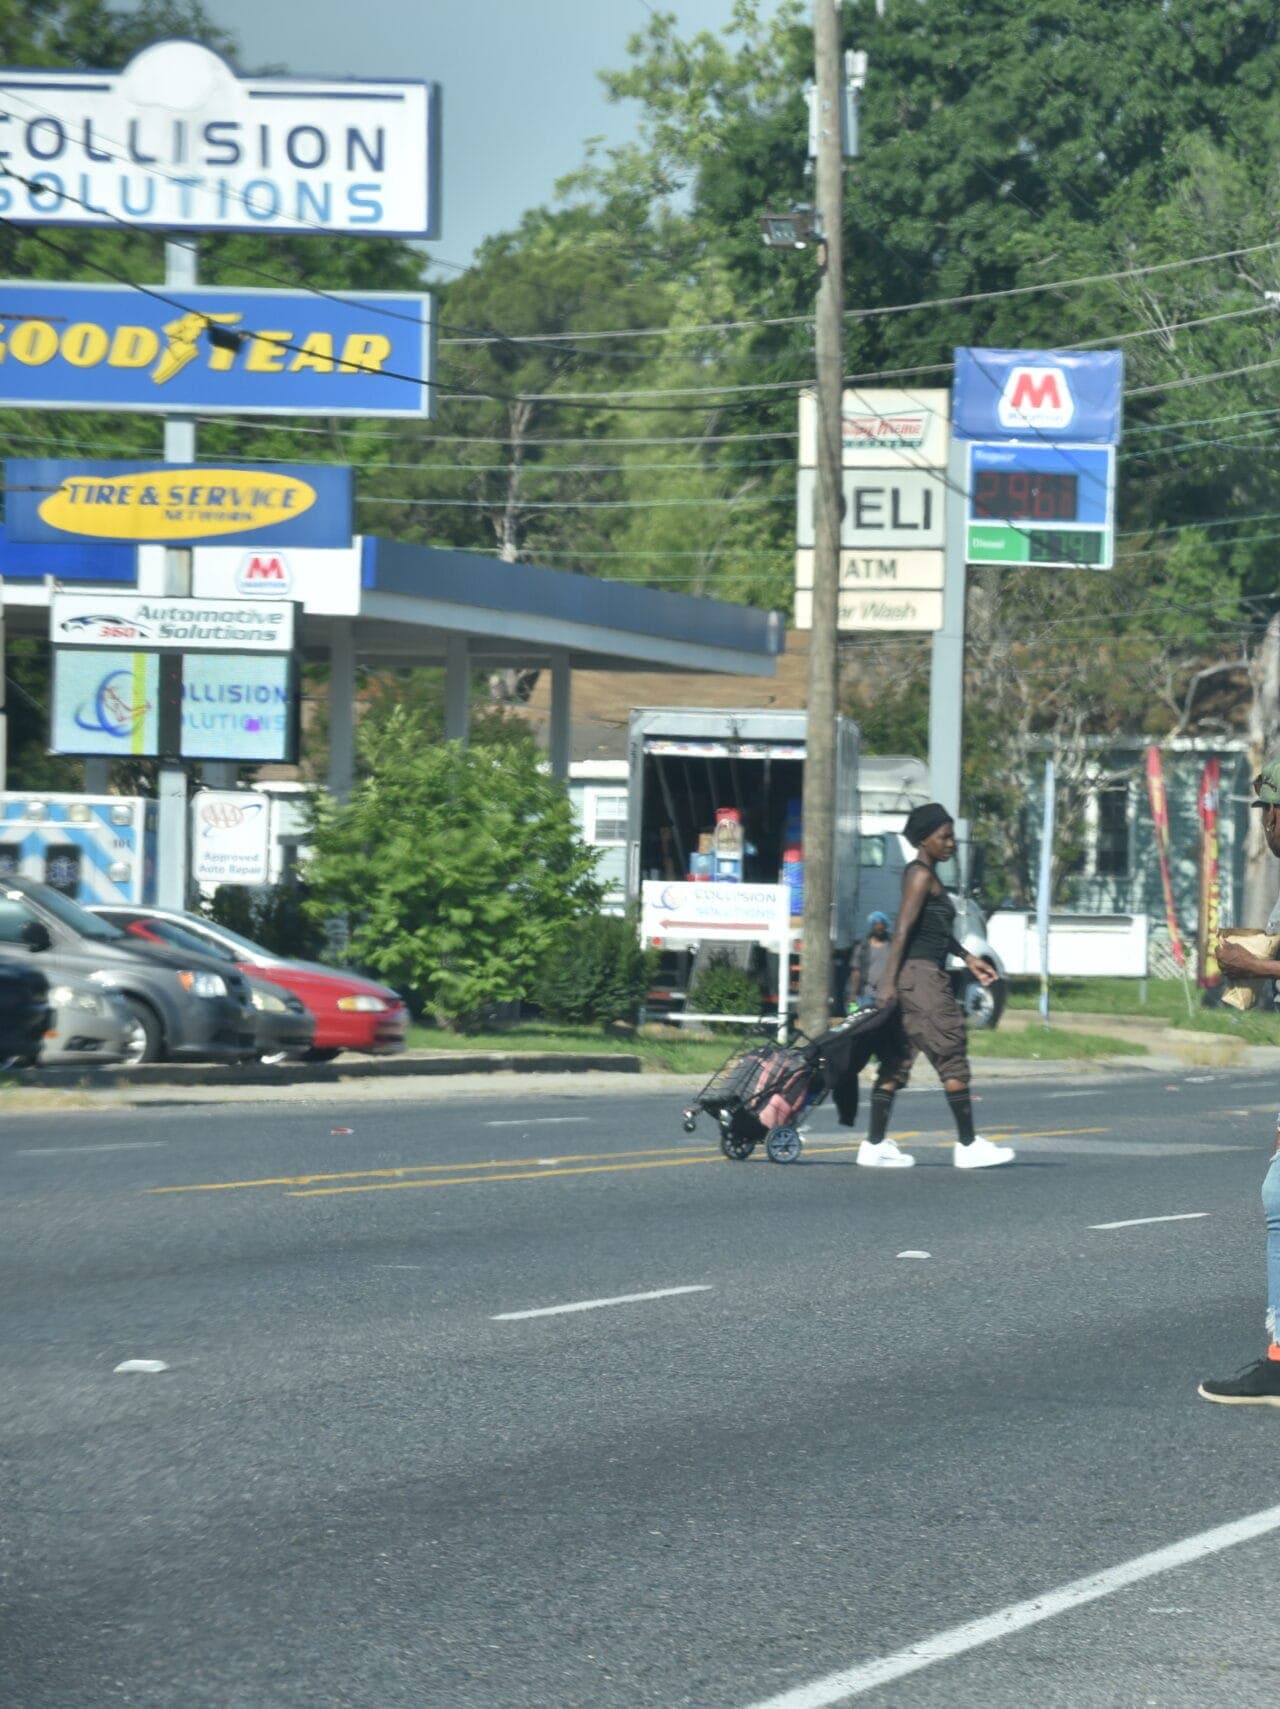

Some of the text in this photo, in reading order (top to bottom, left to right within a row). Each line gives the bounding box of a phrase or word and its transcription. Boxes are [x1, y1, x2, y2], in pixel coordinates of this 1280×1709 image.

[0, 319, 391, 374] OODEAR
[1010, 372, 1062, 409] M
[68, 483, 298, 509] TIRE & SERVICE
[812, 485, 933, 531] ELI
[244, 556, 286, 580] M
[844, 558, 897, 579] ATM
[136, 604, 285, 625] Automotive
[838, 606, 856, 620] ar
[157, 624, 278, 642] Solutions
[180, 683, 288, 704] LLISION
[180, 713, 286, 731] LUTINS
